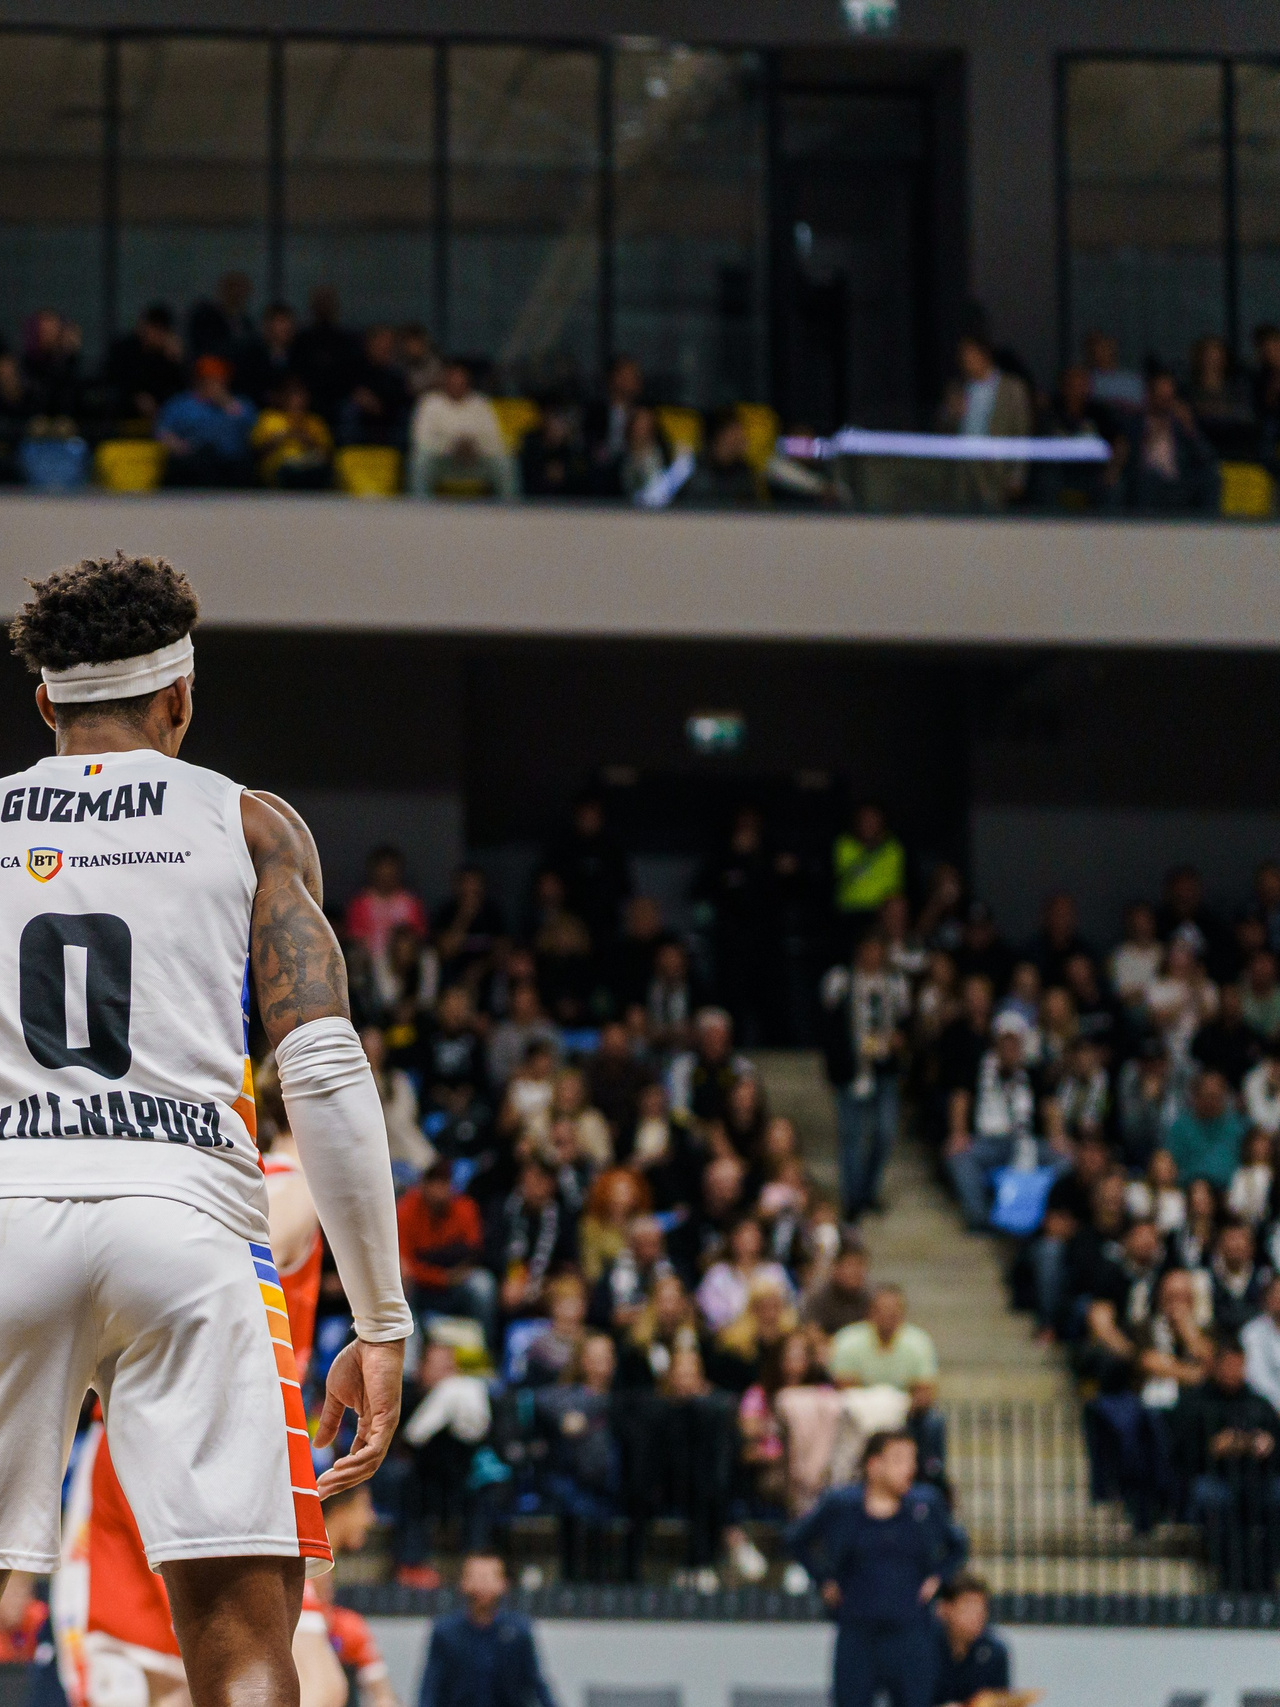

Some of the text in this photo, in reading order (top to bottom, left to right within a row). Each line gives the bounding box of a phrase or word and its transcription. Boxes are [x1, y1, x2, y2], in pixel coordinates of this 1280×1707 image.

[1, 781, 168, 823] GUZMAN
[34, 855, 55, 867] BT
[20, 912, 132, 1080] 0
